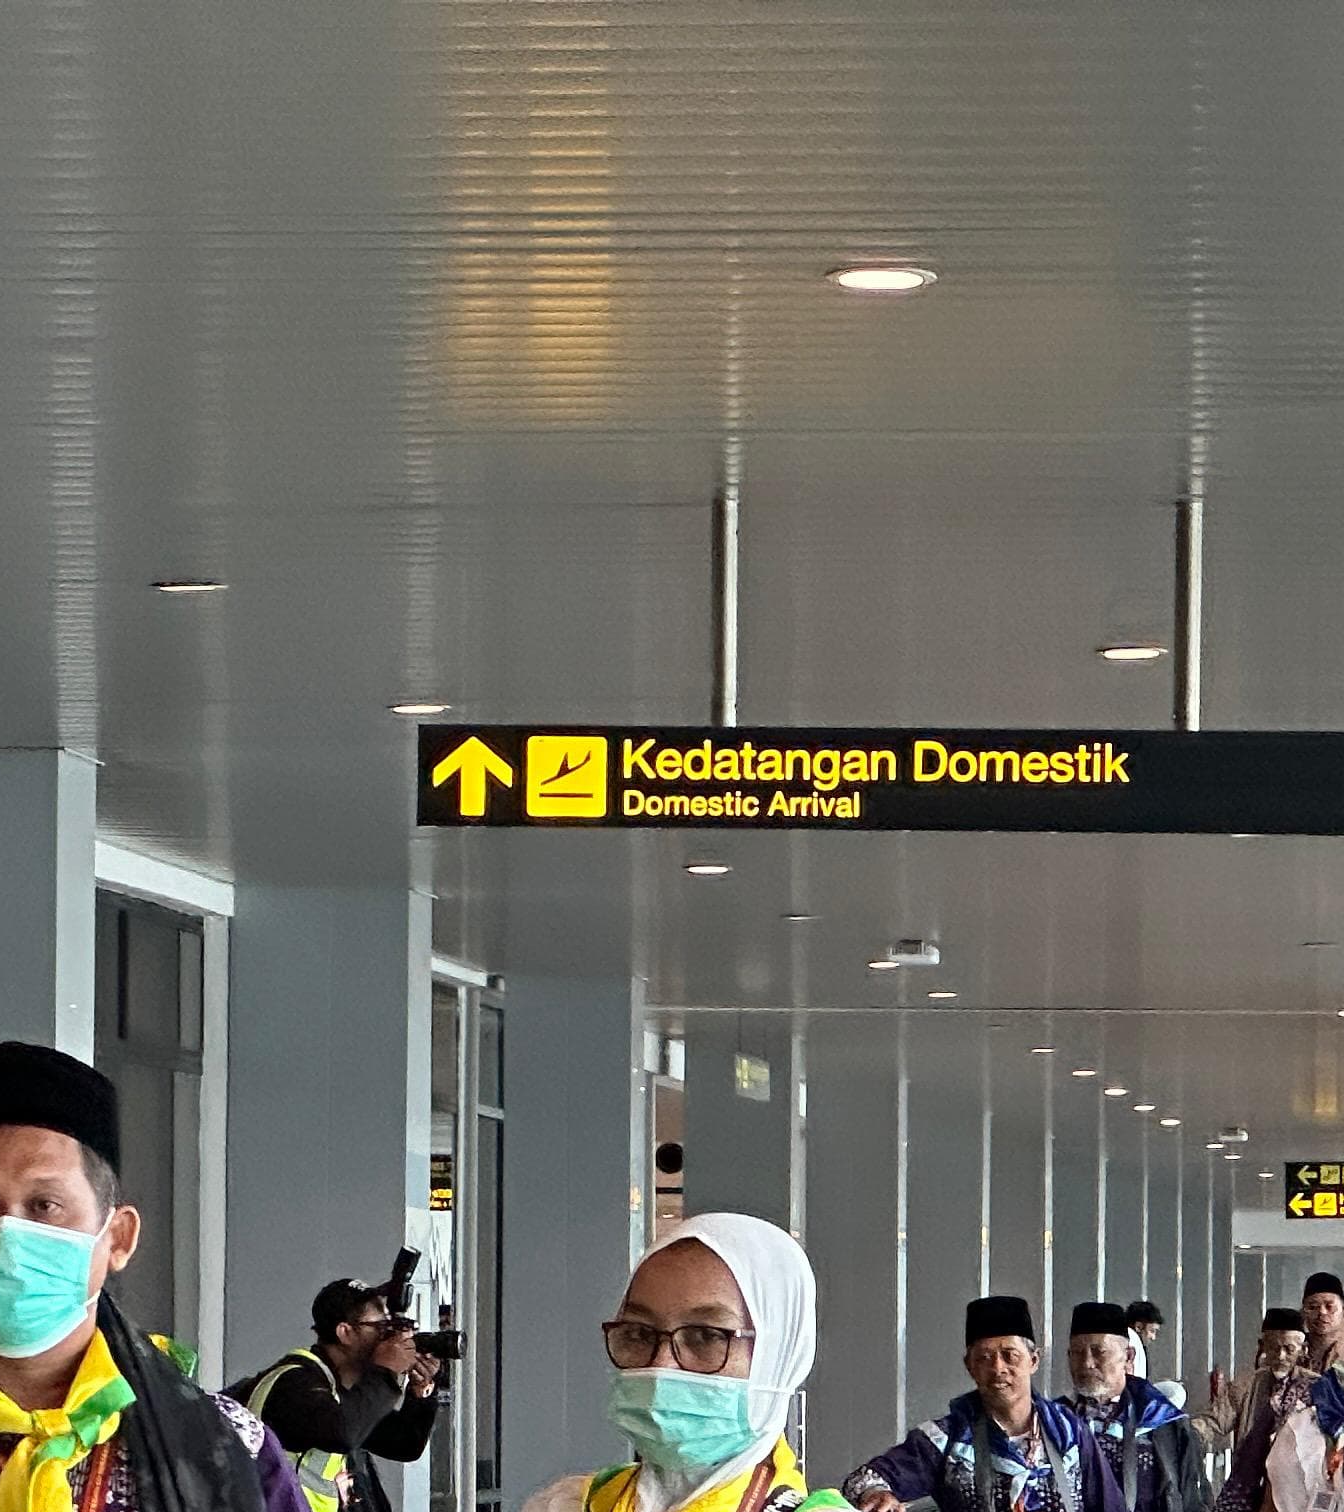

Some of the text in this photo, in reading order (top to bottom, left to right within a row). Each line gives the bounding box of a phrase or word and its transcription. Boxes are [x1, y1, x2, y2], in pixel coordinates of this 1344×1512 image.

[623, 738, 1130, 791] Kedatangan Domestik
[623, 789, 861, 818] Domestic Arrival
